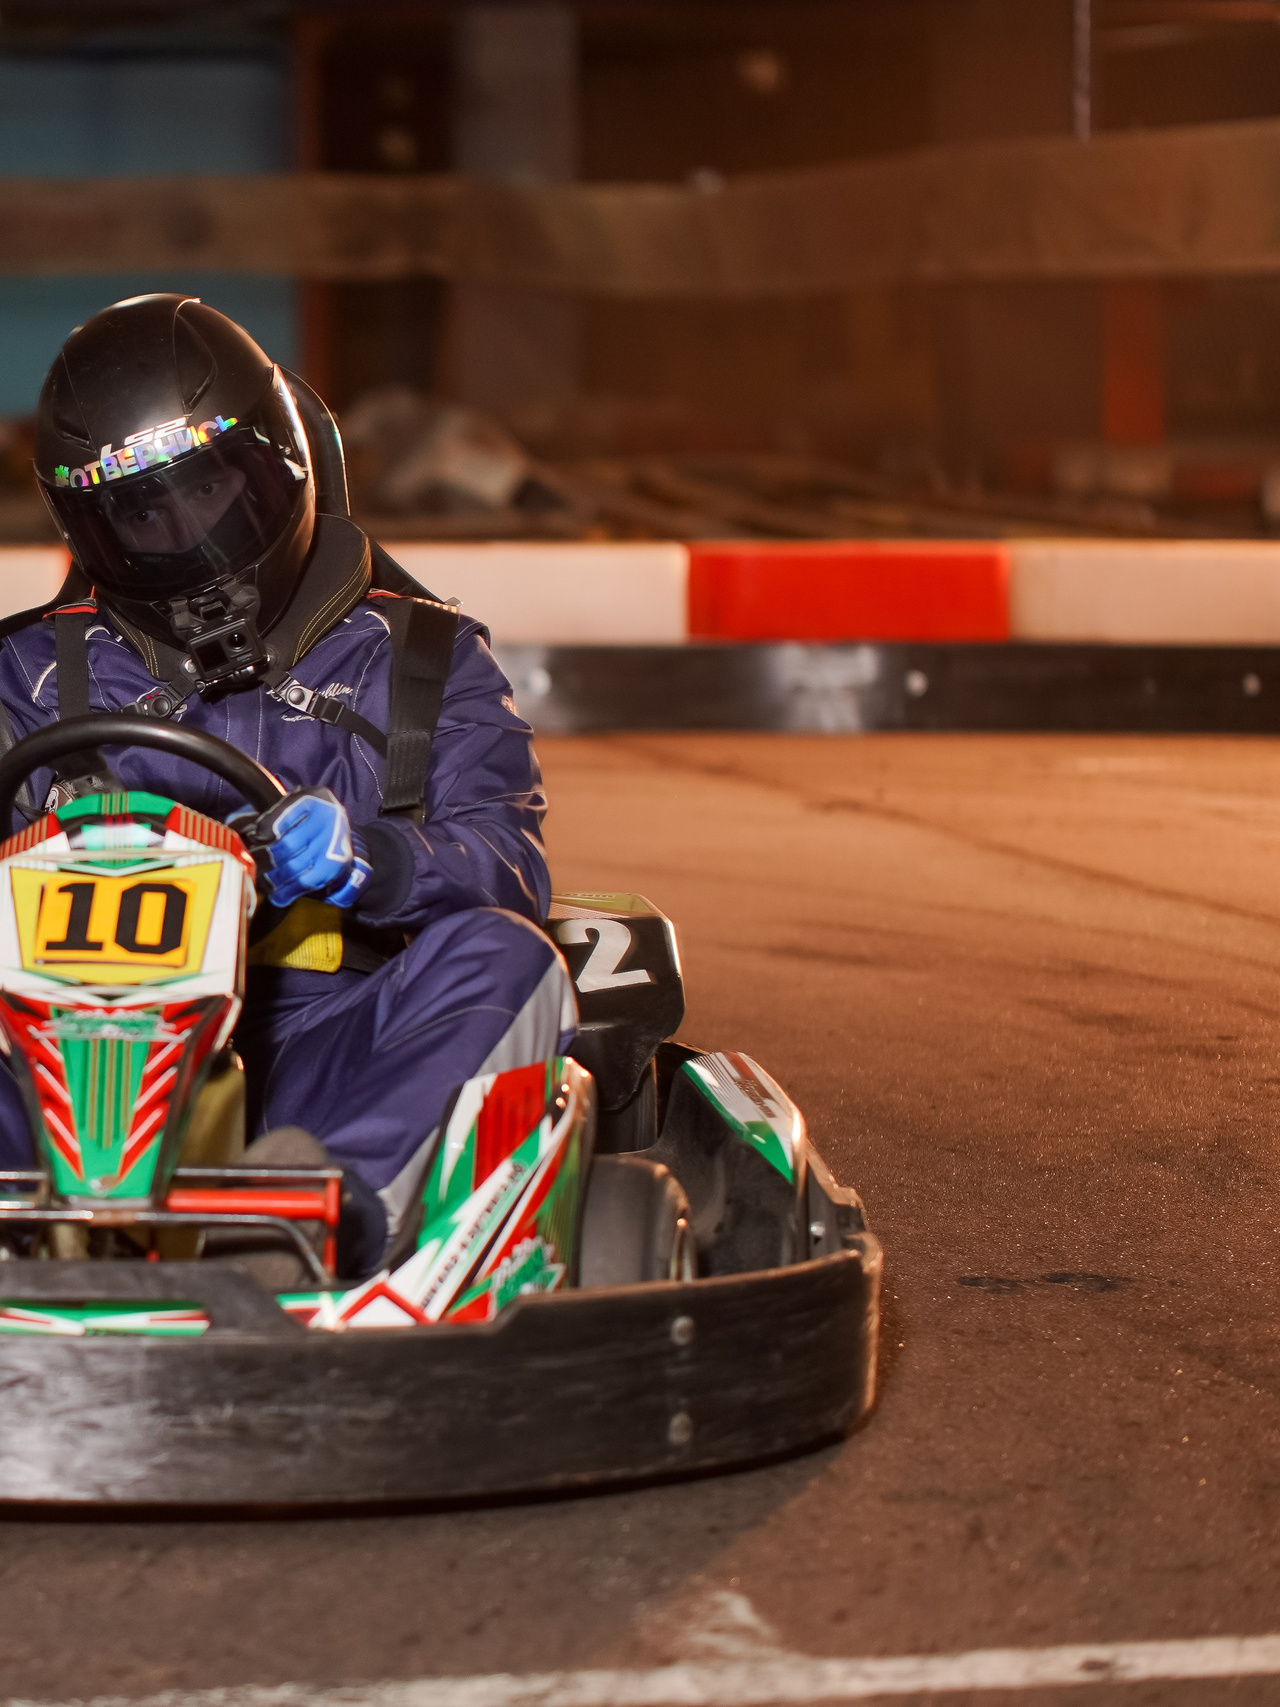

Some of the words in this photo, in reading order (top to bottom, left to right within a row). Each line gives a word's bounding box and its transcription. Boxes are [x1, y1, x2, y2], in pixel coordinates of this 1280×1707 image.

[54, 415, 239, 488] #ОТВЕРНИСЬ
[100, 416, 188, 460] LS2
[45, 882, 188, 955] 10
[556, 918, 652, 994] 2
